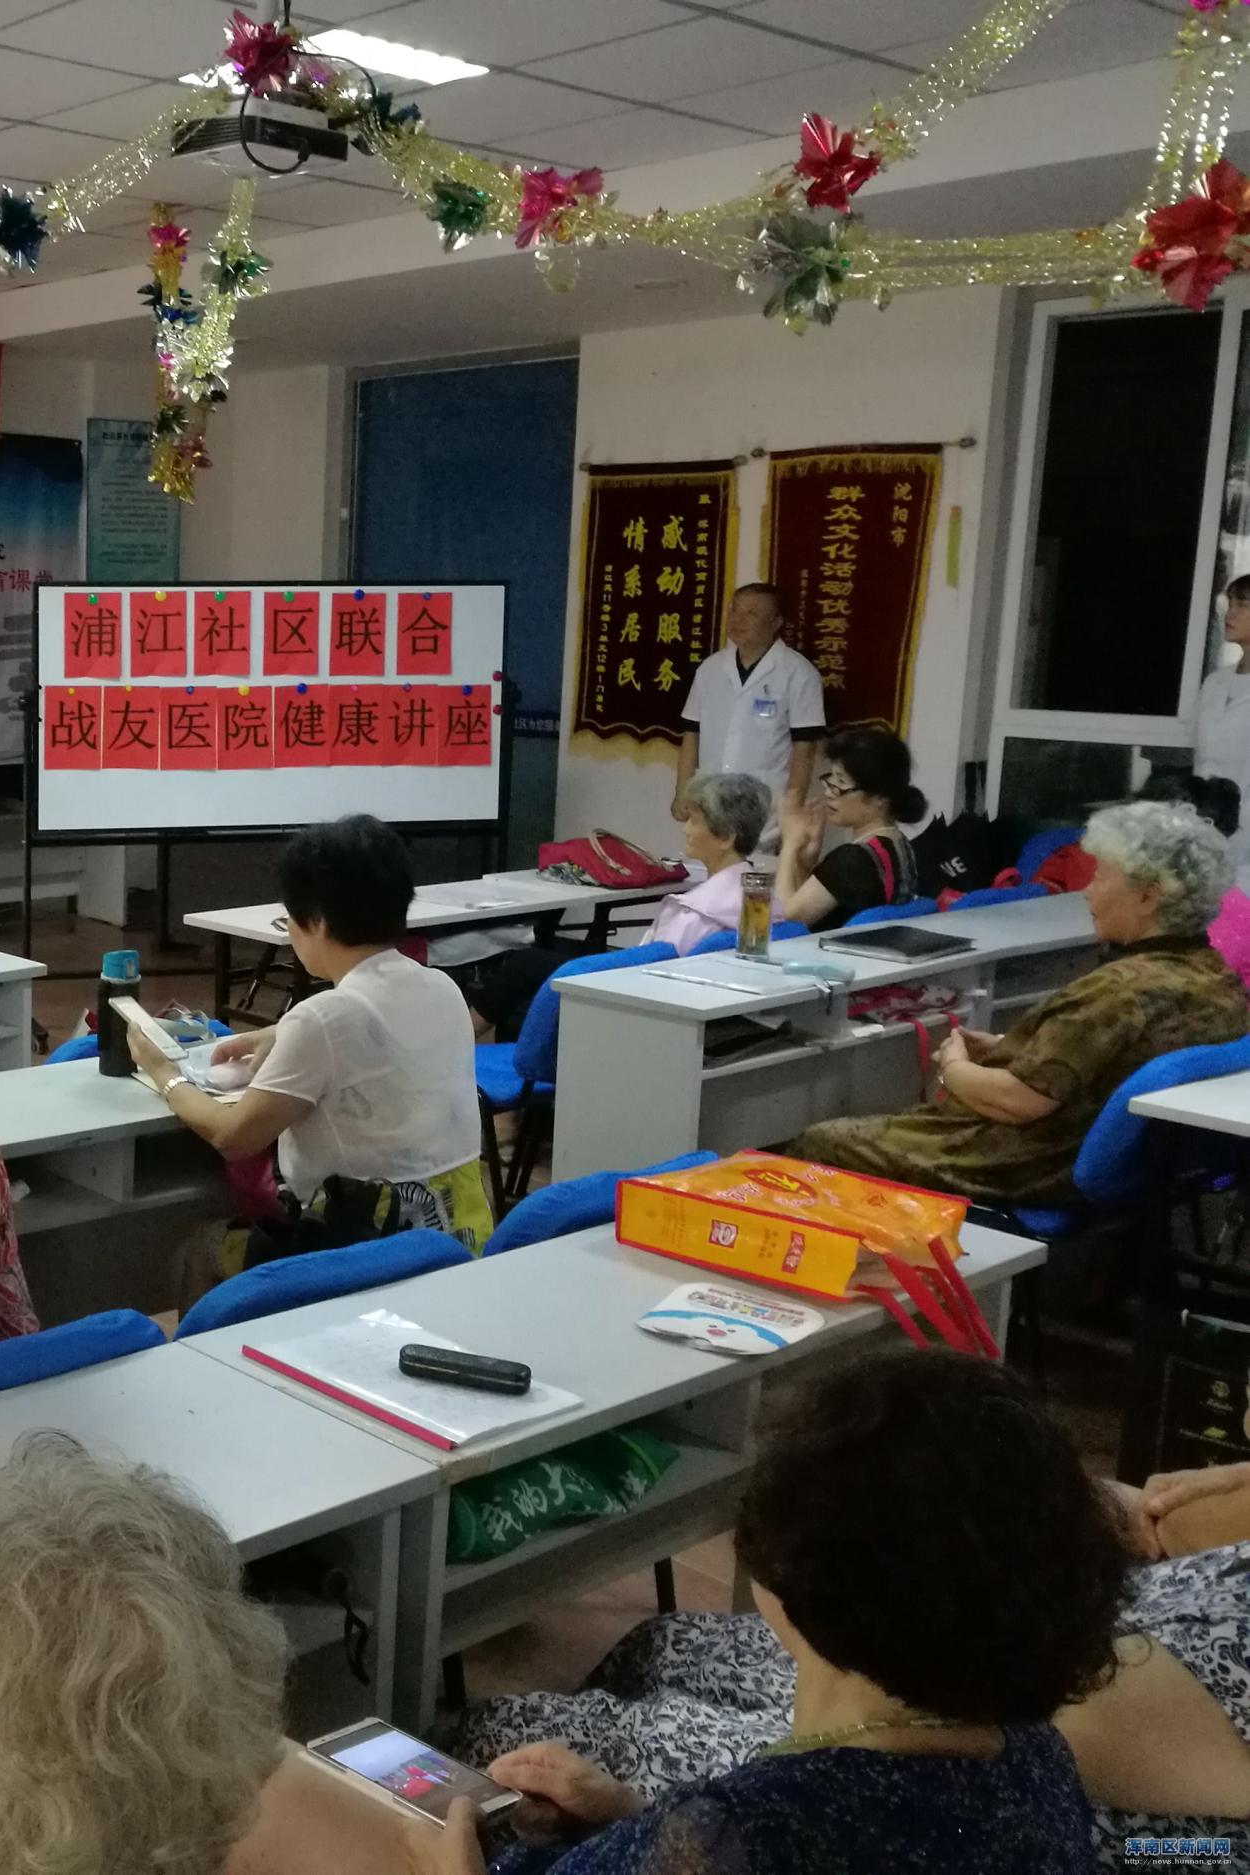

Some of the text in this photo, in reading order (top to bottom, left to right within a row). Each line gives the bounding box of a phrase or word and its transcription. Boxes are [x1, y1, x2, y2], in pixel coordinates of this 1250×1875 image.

[891, 483, 913, 547] 沈阳市
[71, 606, 448, 658] 浦江社区联合
[617, 517, 648, 691] 情系居民
[654, 515, 688, 692] 感动服务
[814, 485, 865, 689] 群众文化活动优秀示范点
[51, 699, 489, 751] 战友医院健康讲座
